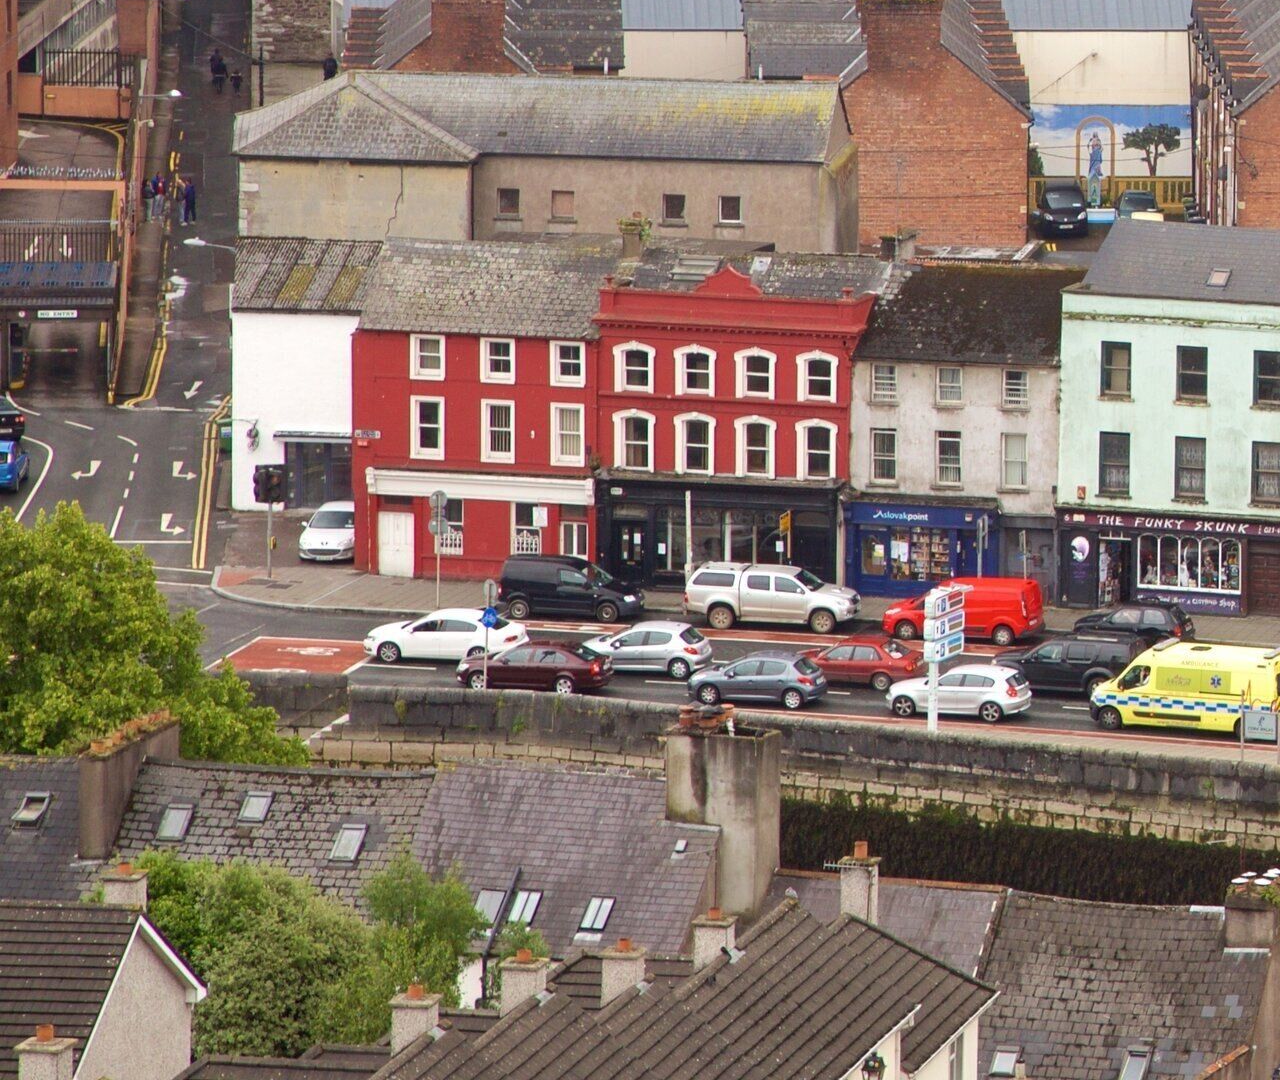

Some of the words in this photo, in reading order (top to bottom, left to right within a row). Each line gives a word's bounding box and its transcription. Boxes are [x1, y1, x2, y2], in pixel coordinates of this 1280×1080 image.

[1097, 514, 1125, 526] THE
[1134, 517, 1184, 529] FUNKY
[1194, 521, 1249, 534] SKUNK
[1181, 660, 1219, 668] AMBULANCE
